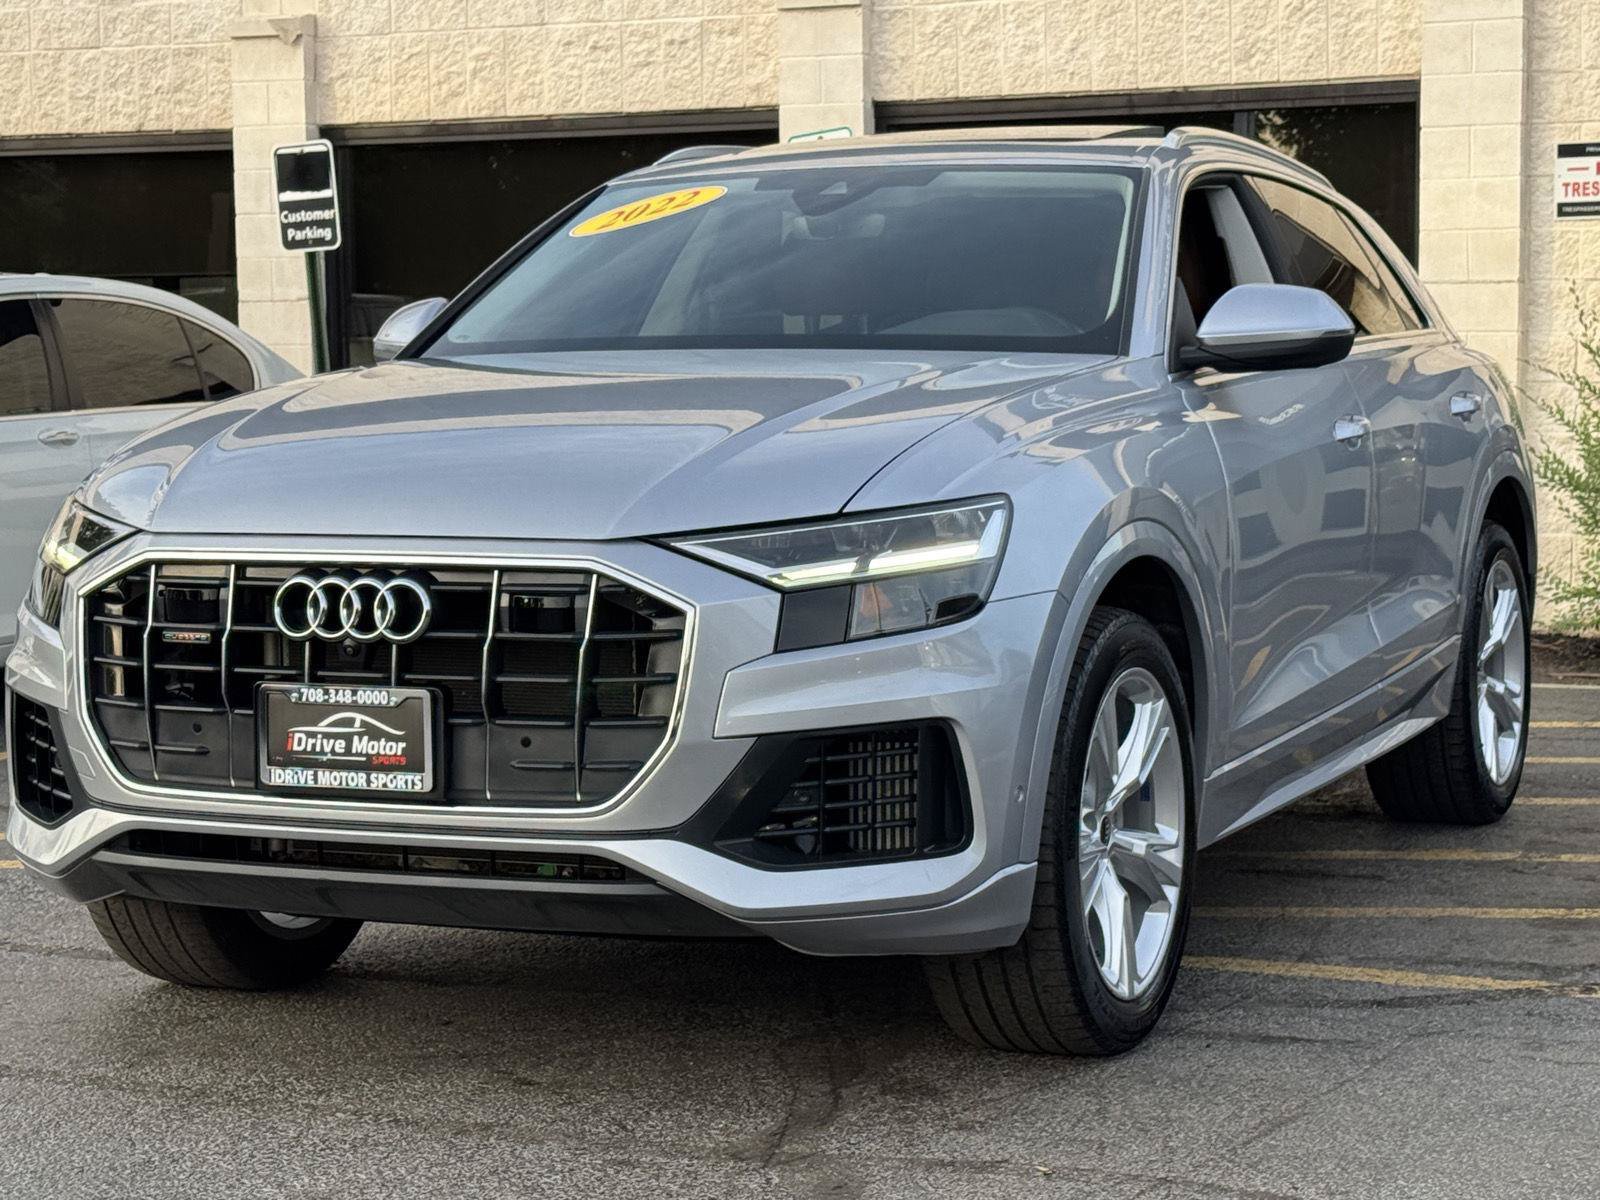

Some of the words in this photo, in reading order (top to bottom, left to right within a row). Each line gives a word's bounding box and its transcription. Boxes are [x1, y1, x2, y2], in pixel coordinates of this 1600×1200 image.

[281, 209, 335, 223] Customer
[597, 190, 701, 231] 2022
[287, 226, 332, 241] Parking
[301, 688, 389, 705] 708-348-0000
[286, 731, 346, 754] iDrive
[351, 735, 406, 755] Motor
[372, 755, 407, 766] SPORTS
[317, 773, 367, 787] MOTOR
[370, 775, 422, 791] SPORTS
